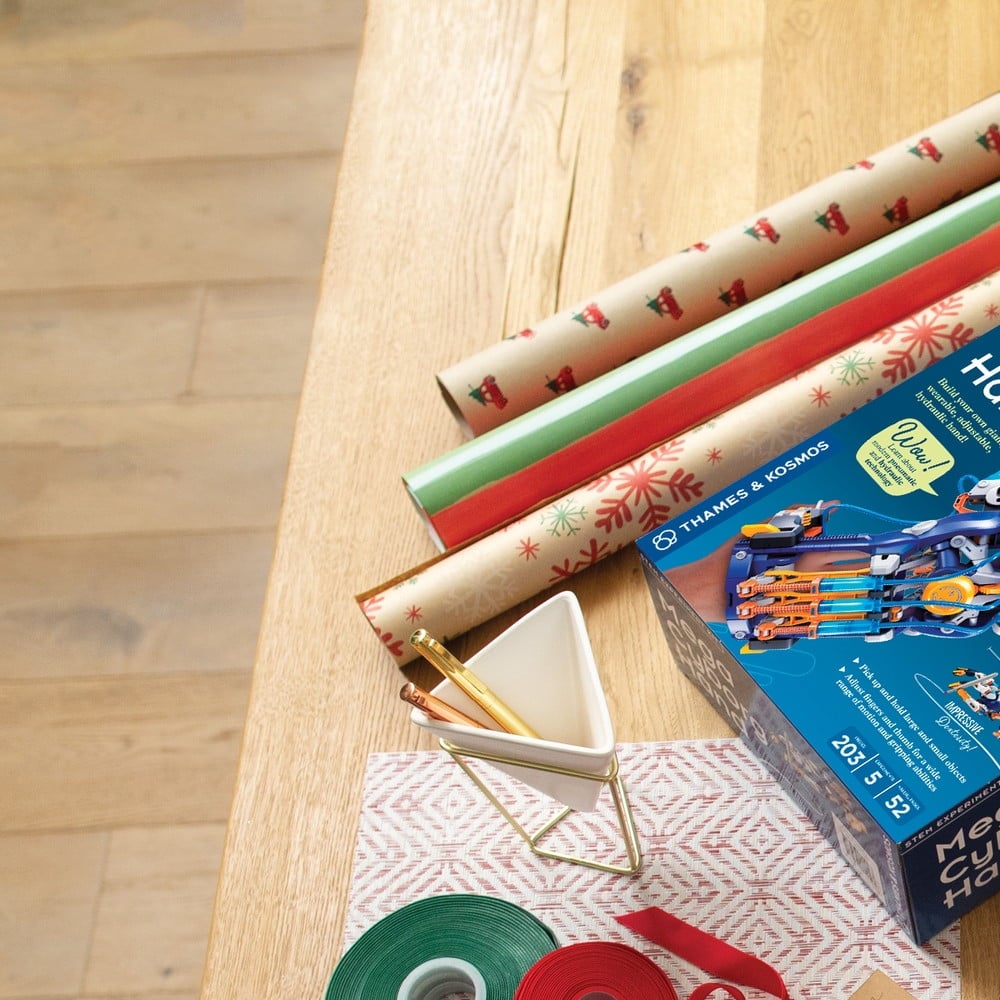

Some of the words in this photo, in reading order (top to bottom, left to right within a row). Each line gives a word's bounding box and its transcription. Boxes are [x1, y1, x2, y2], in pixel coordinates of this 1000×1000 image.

[916, 392, 948, 424] hydraulic
[946, 423, 969, 443] hand!
[927, 385, 957, 418] wearable,
[957, 416, 991, 453] adjustable,
[938, 378, 956, 398] Build
[954, 397, 973, 415] your
[972, 413, 987, 428] own
[679, 489, 749, 533] THAMES
[751, 482, 764, 491] &
[765, 441, 829, 483] KOSMOS
[891, 422, 950, 473] Wow!
[658, 589, 735, 688] Mega
[667, 619, 768, 746] Cyborg
[675, 644, 749, 737] Hand
[845, 674, 865, 695] Adjust
[863, 693, 883, 717] fingers
[882, 714, 897, 729] and
[893, 725, 914, 750] thumb
[912, 748, 922, 759] for
[925, 760, 941, 781] wide
[859, 664, 873, 680] Pick
[871, 678, 880, 689] up
[880, 685, 891, 701] and
[890, 695, 905, 715] hold
[904, 713, 919, 732] large
[918, 728, 933, 745] and
[929, 742, 947, 761] small
[944, 759, 966, 784] objects
[935, 716, 978, 752] Dexterity!
[831, 734, 866, 765] 203
[864, 770, 883, 785] 5
[885, 795, 910, 819] 52
[836, 679, 853, 698] range
[852, 696, 860, 706] of
[858, 704, 879, 728] motion
[878, 724, 893, 740] and
[887, 737, 915, 768] gripping
[912, 762, 937, 792] abilities
[904, 827, 933, 848] STEM
